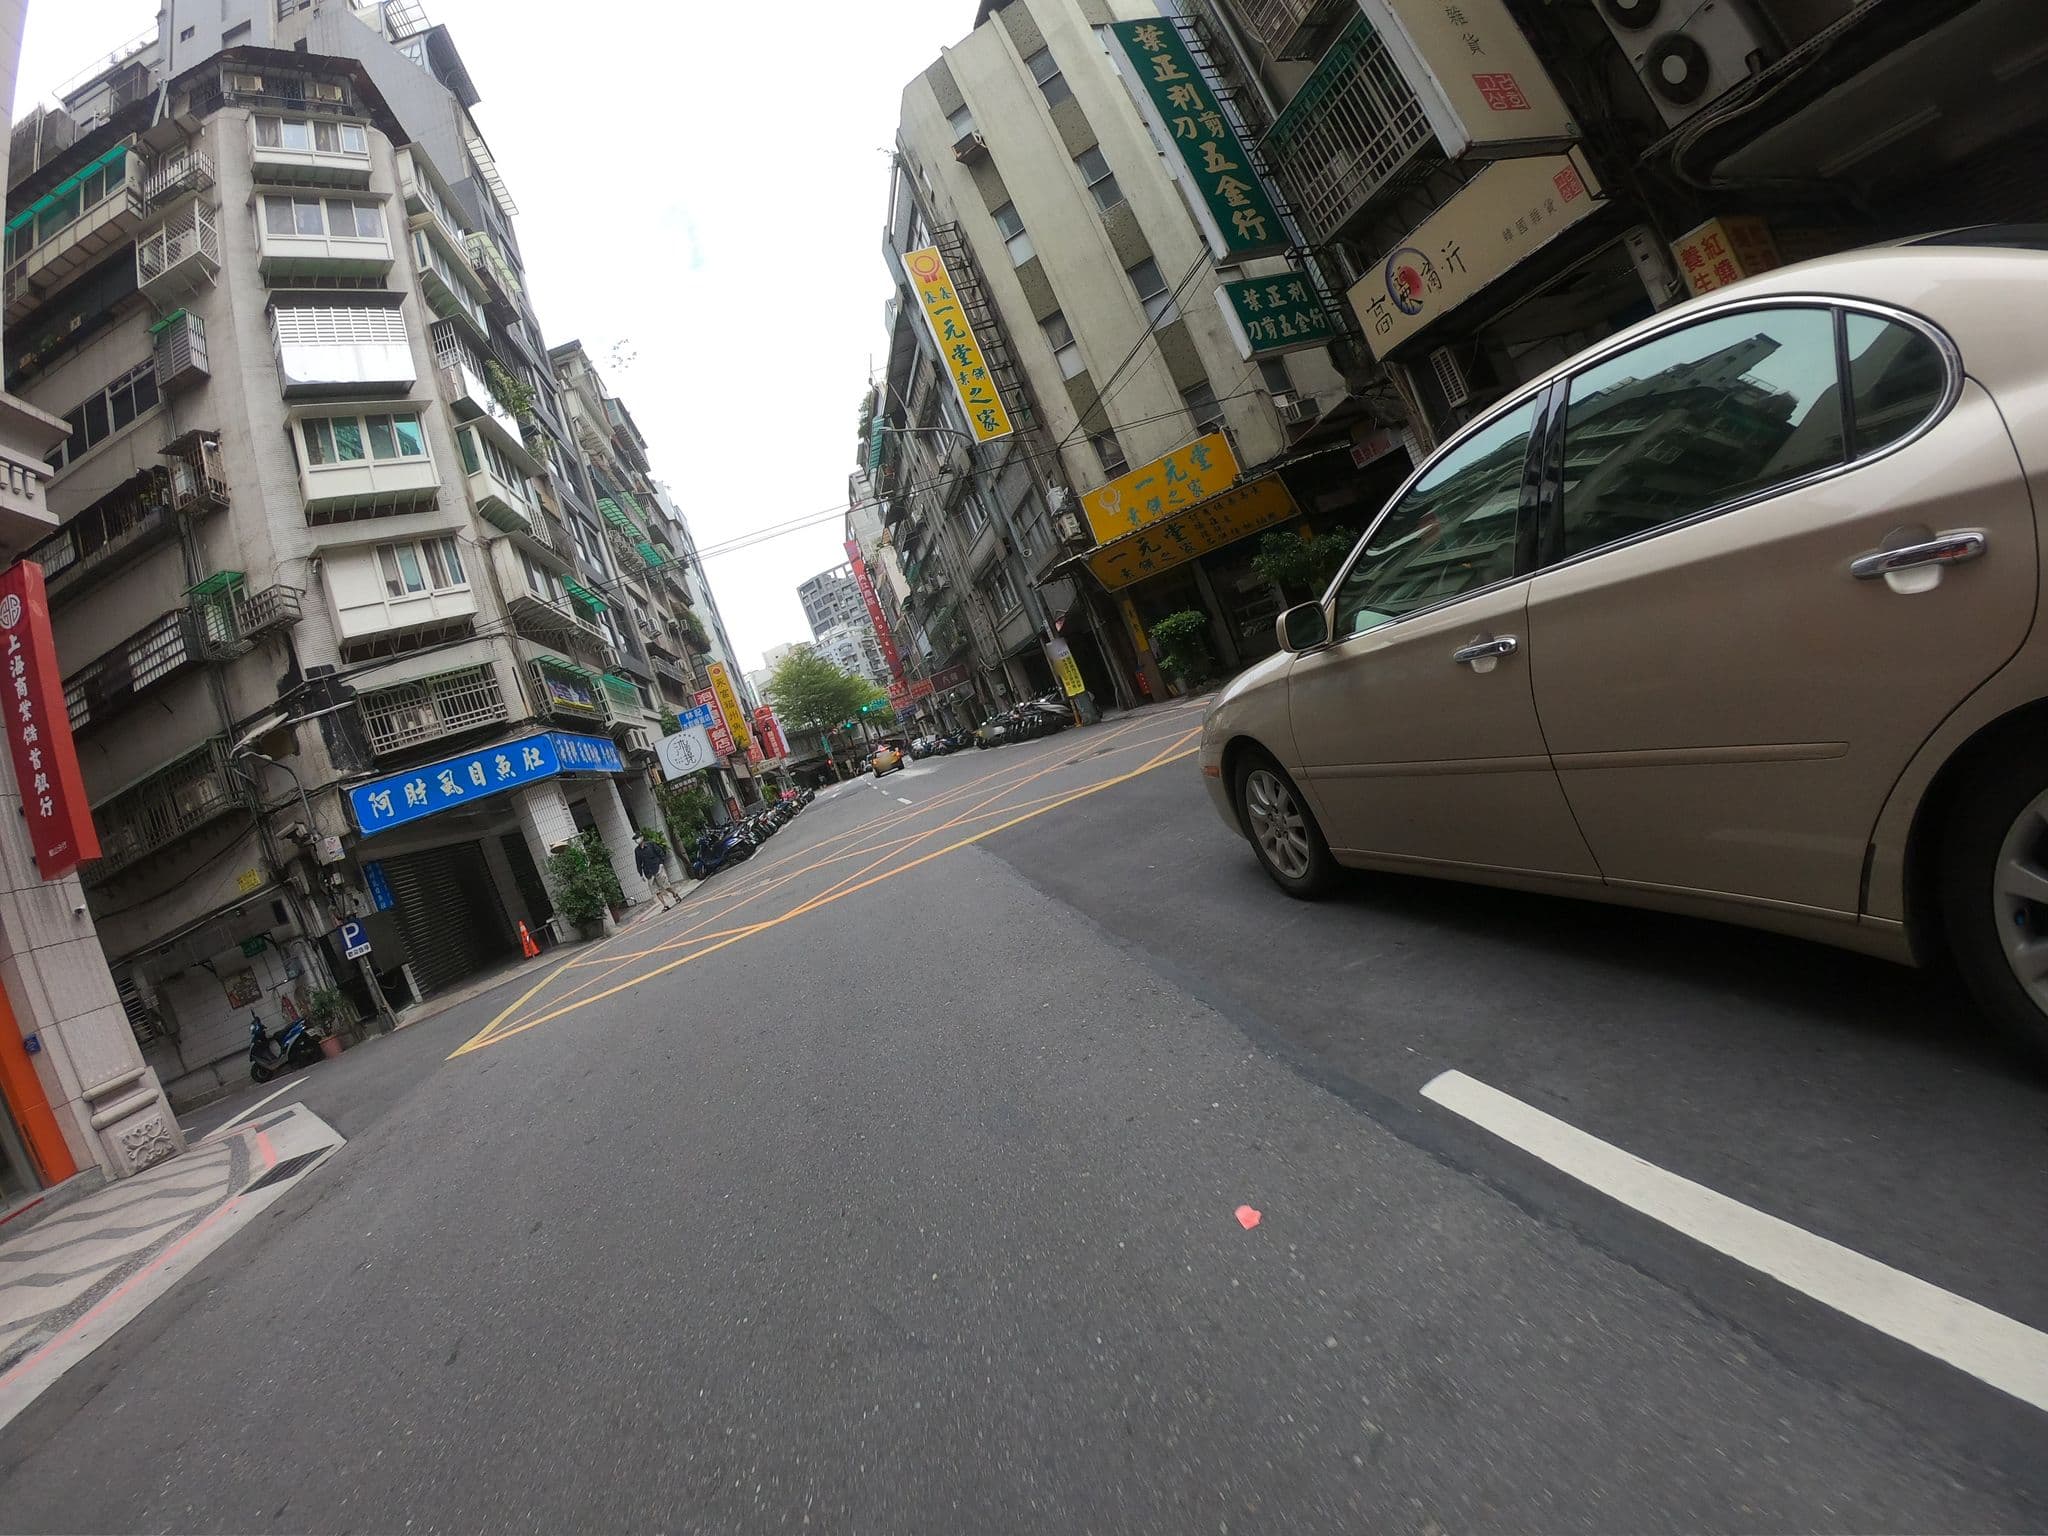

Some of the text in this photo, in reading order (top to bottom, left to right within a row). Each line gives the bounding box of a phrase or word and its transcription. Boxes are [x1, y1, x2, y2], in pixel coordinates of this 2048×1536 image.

[1242, 280, 1310, 312] 葉正利
[1247, 308, 1330, 341] 刀剪五金行
[1135, 444, 1213, 491] 一元堂
[1108, 523, 1186, 564] 一元堂
[342, 922, 359, 948] P
